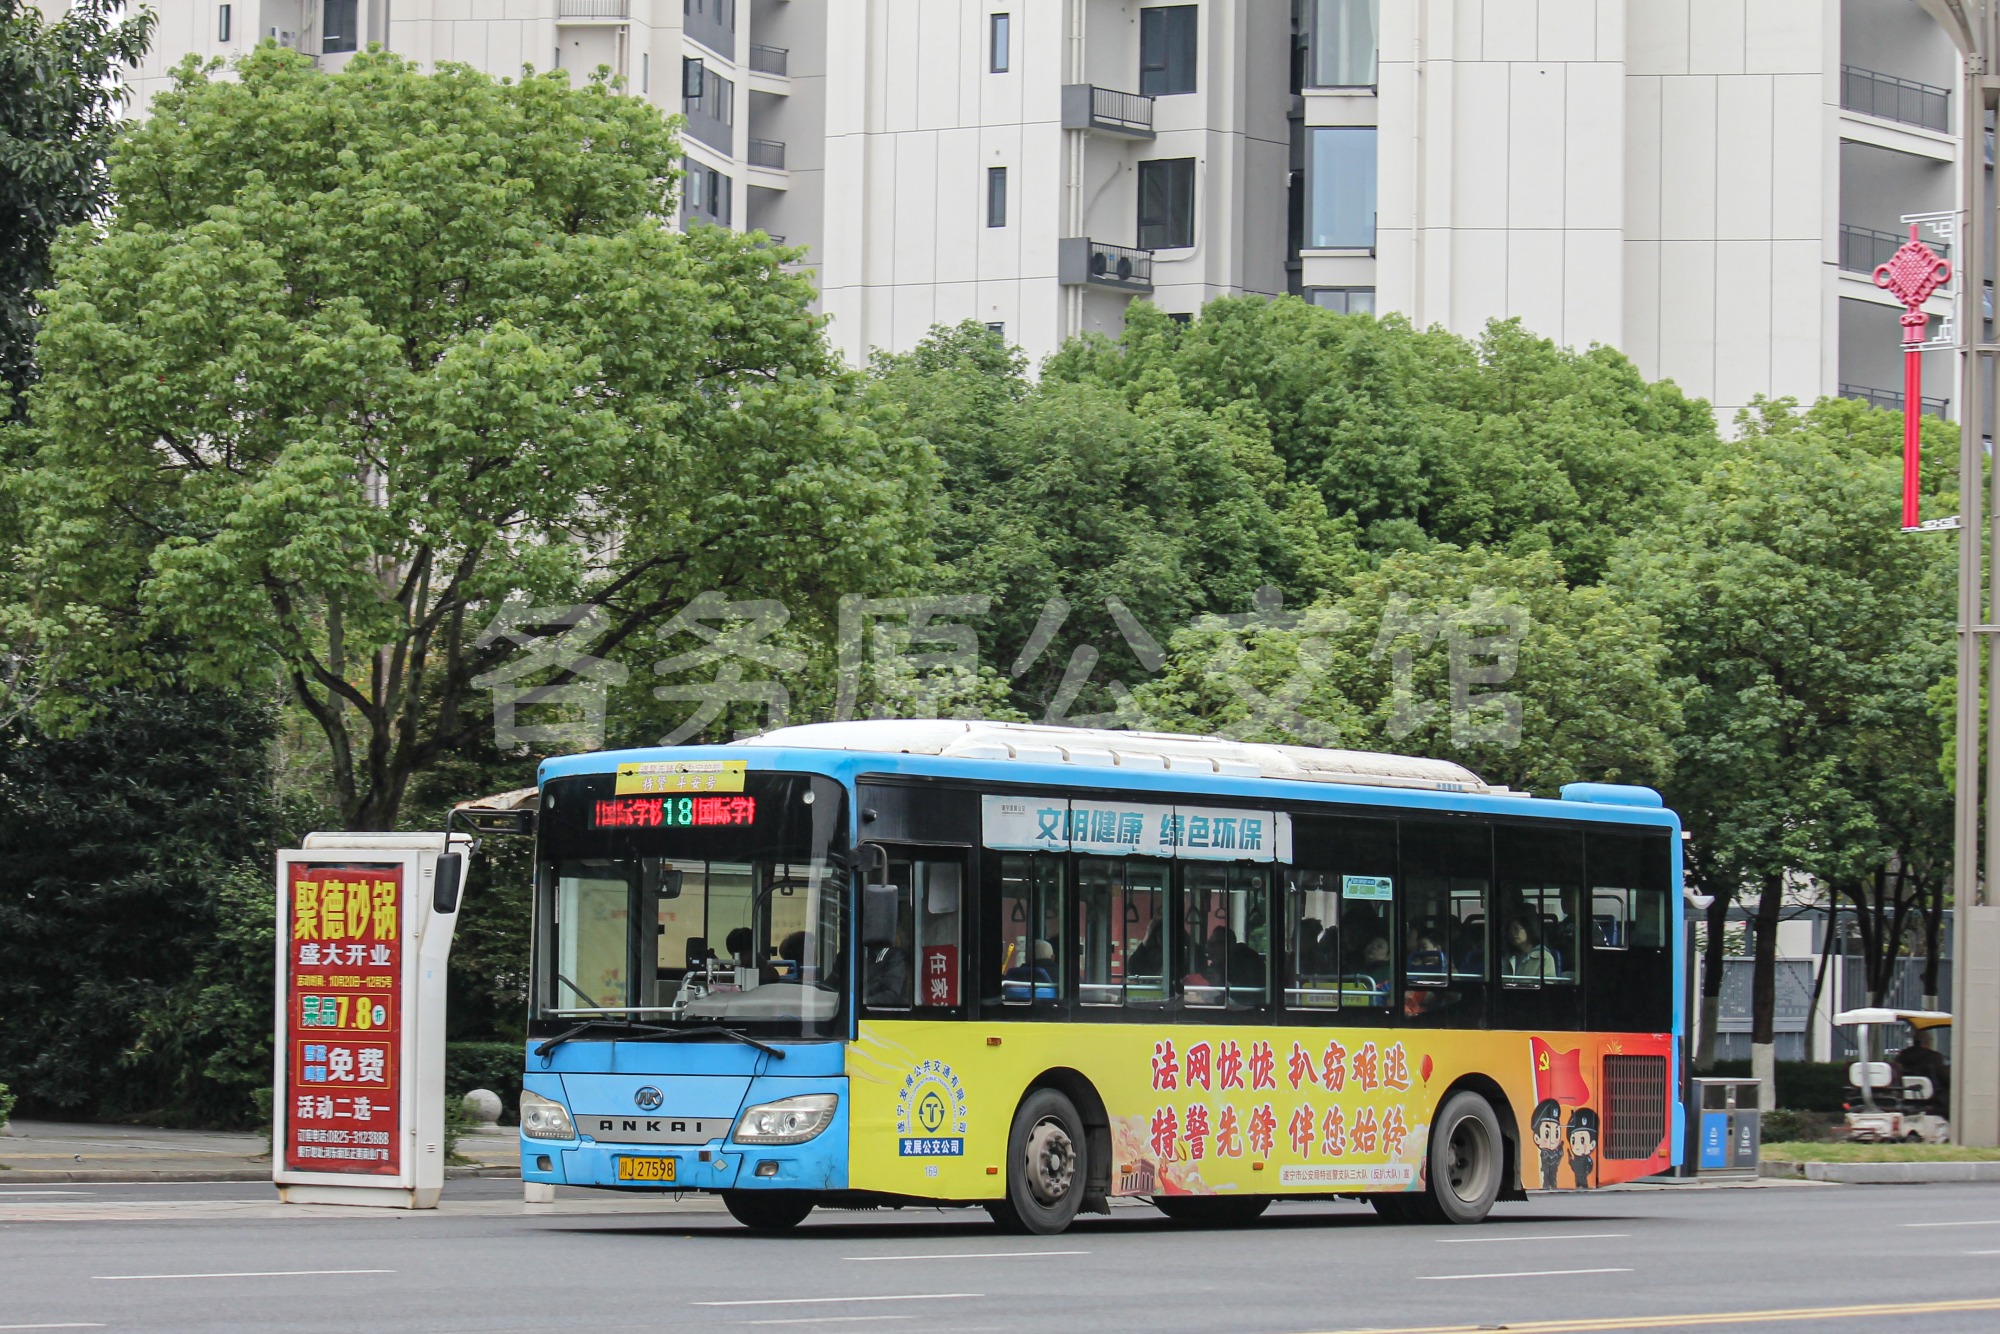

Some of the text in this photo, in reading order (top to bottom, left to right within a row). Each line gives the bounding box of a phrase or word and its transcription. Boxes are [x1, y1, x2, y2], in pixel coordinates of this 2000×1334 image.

[663, 798, 692, 826] 18
[1036, 807, 1263, 850] 文明健康 绿色环保
[294, 879, 397, 940] 聚德砂锅
[299, 943, 391, 966] 盛大开业
[327, 1047, 385, 1083] 免费
[1151, 1040, 1410, 1093] 法网恢恢 扒窃难逃
[297, 1095, 391, 1121] 活动二选一
[599, 1120, 702, 1132] ANKAI
[1150, 1103, 1408, 1160] 特警先锋 伴您始终
[903, 1139, 960, 1154] 发展公交公司
[925, 1166, 938, 1177] 169
